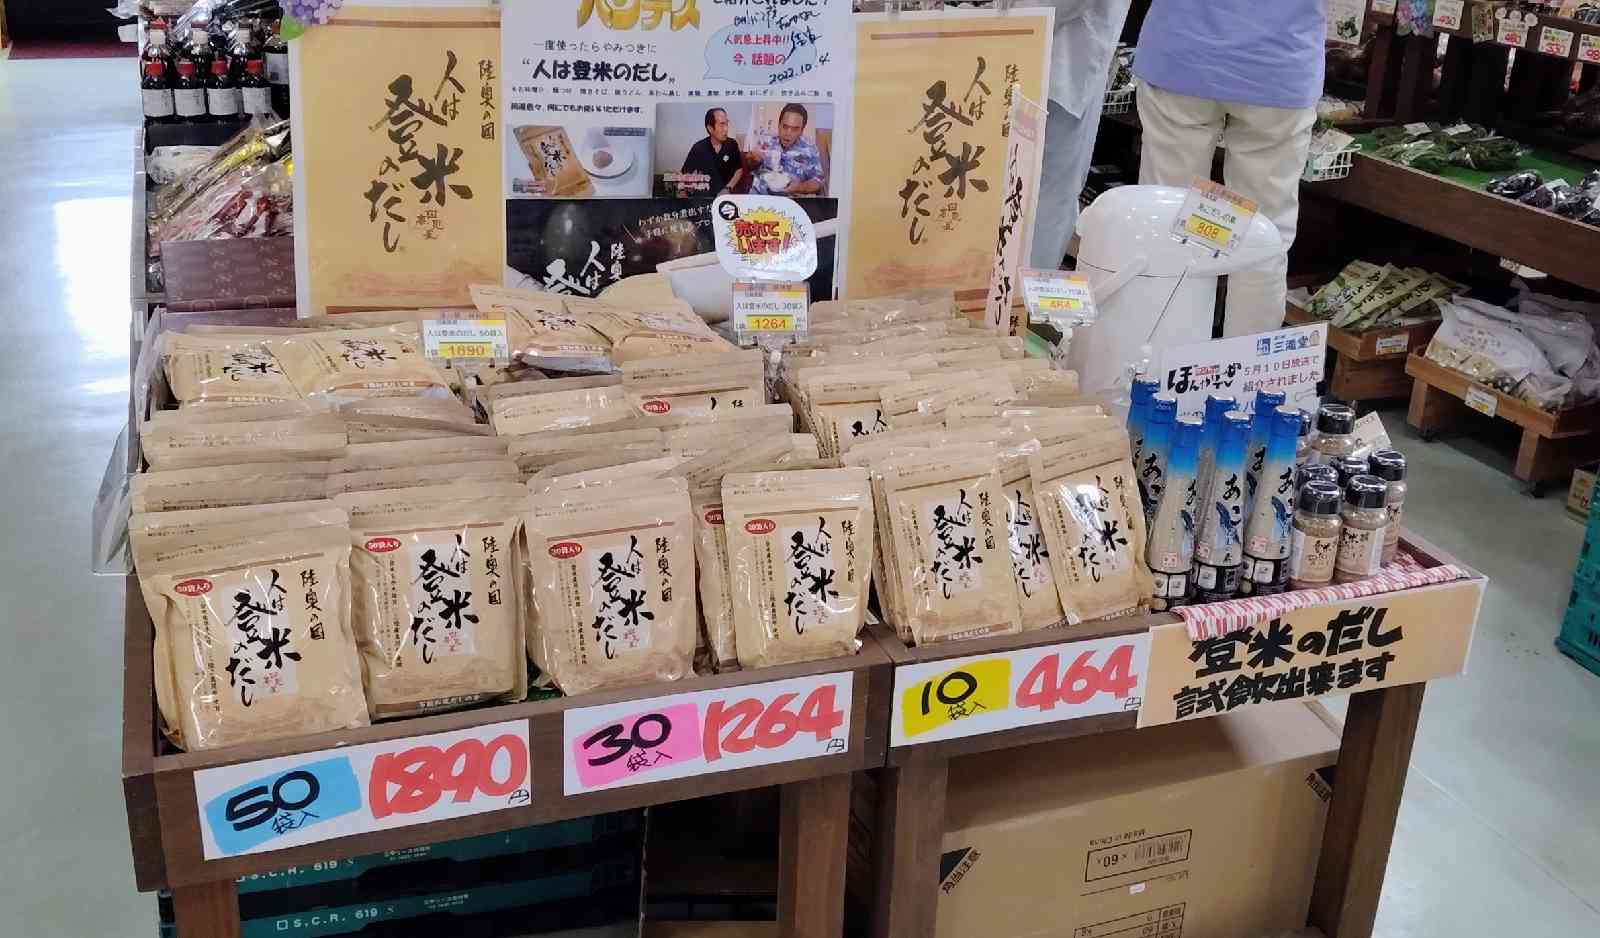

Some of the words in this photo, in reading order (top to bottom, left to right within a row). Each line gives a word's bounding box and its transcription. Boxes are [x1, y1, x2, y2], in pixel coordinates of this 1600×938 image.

[755, 318, 787, 330] 1264
[447, 344, 485, 356] 1890
[1188, 606, 1404, 679] 登米のだし
[920, 671, 978, 716] 10
[1016, 645, 1138, 712] 464
[583, 713, 672, 767] 30
[702, 684, 844, 763] 1264
[225, 769, 320, 832] 50
[367, 733, 528, 819] 1890
[313, 860, 337, 872] 619
[354, 906, 378, 921] 619
